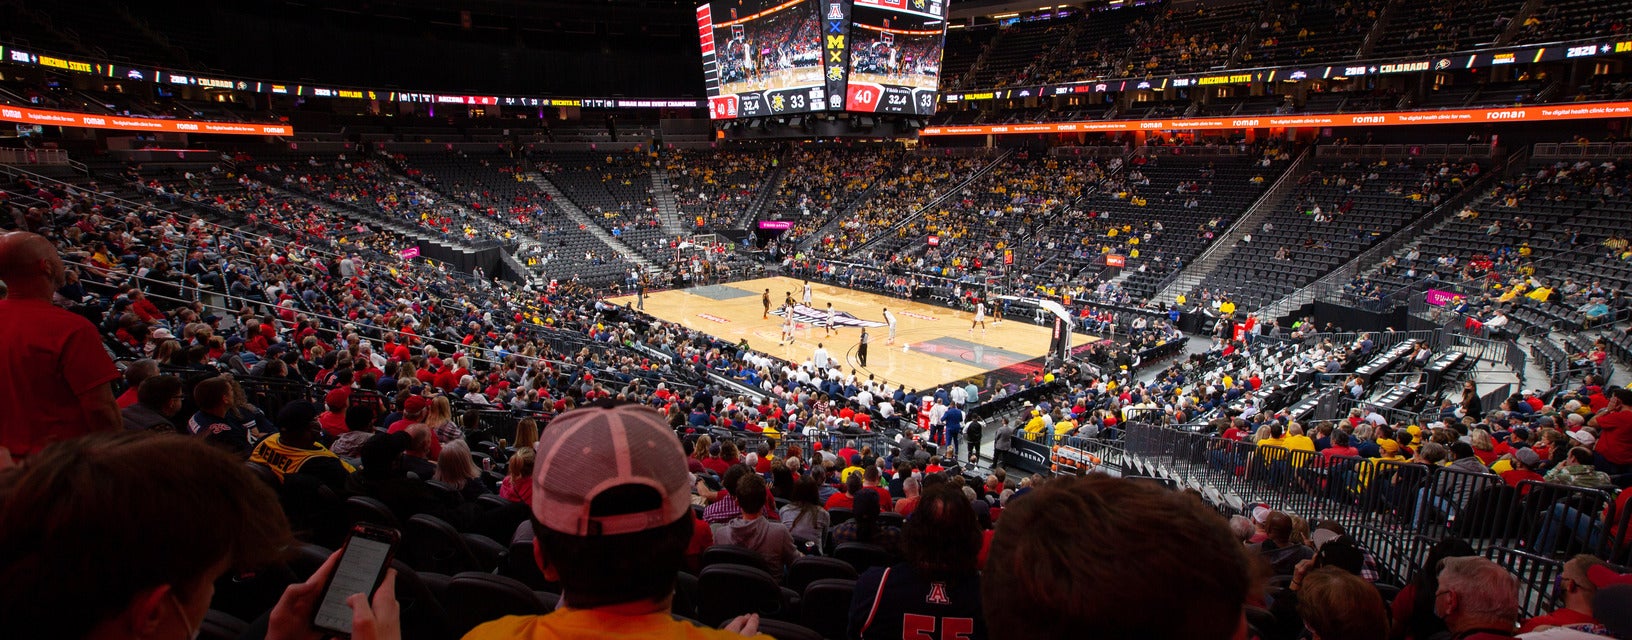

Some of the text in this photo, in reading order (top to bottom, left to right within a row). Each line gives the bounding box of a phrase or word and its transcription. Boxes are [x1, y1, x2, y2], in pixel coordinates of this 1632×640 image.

[828, 3, 843, 19] A
[827, 35, 844, 48] M
[1566, 45, 1596, 58] 2020
[39, 55, 68, 69] ARIZONA
[68, 61, 92, 72] STATE
[1345, 62, 1430, 75] 2019 COLORADO
[198, 78, 233, 88] COLORADO
[1198, 76, 1228, 85] ARIZONA
[1230, 74, 1252, 83] STATE
[790, 95, 804, 108] 33
[855, 90, 872, 104] 40
[888, 95, 906, 104] 32.4
[921, 94, 932, 107] 33
[744, 100, 760, 110] 32.4
[1486, 110, 1526, 119] roman
[1020, 452, 1041, 462] ARENA
[926, 582, 950, 604] A
